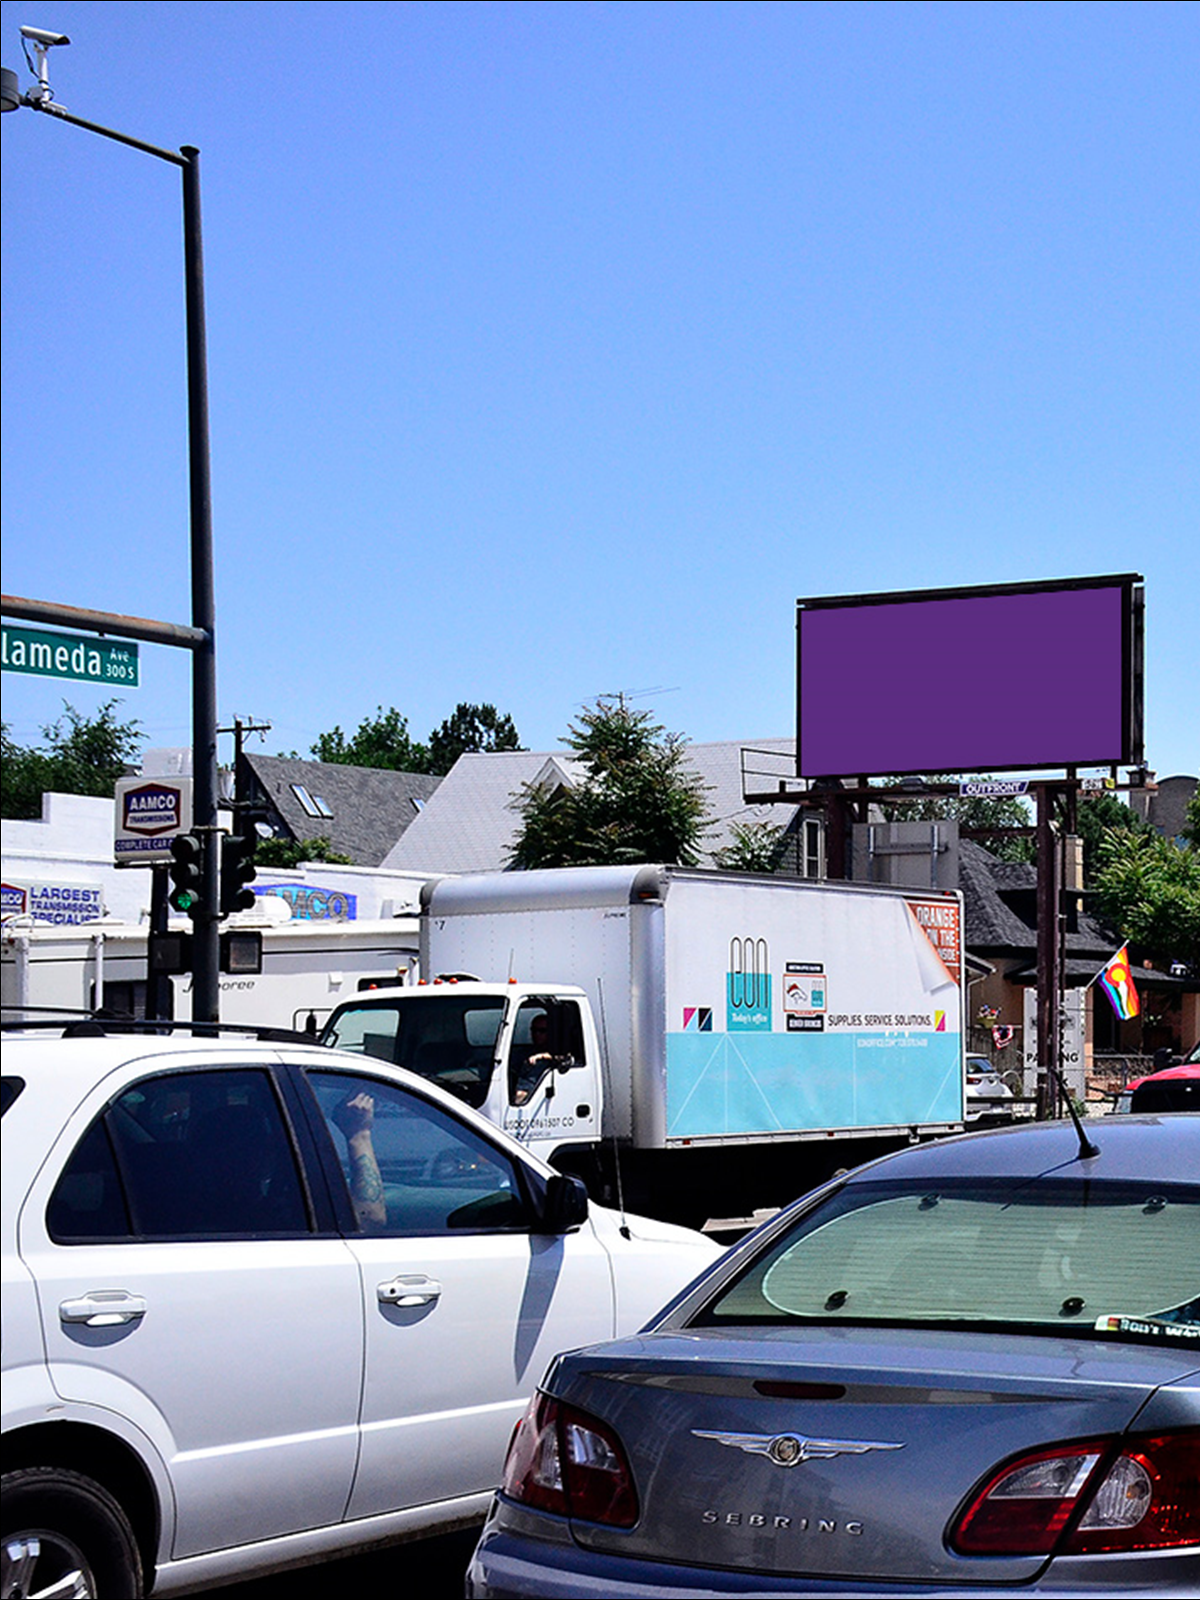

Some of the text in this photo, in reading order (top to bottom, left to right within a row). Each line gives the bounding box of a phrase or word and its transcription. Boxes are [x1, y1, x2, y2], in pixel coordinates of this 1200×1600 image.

[1, 631, 130, 676] lameda Ave
[106, 663, 135, 679] 300 S
[966, 783, 1021, 794] OUTFRONT
[130, 794, 176, 810] AAMCO
[31, 886, 100, 902] LARGEST
[31, 900, 100, 913] TRANSMISSION
[917, 905, 956, 928] ORANGE
[940, 930, 955, 946] THE
[702, 1510, 864, 1536] SEBRING
